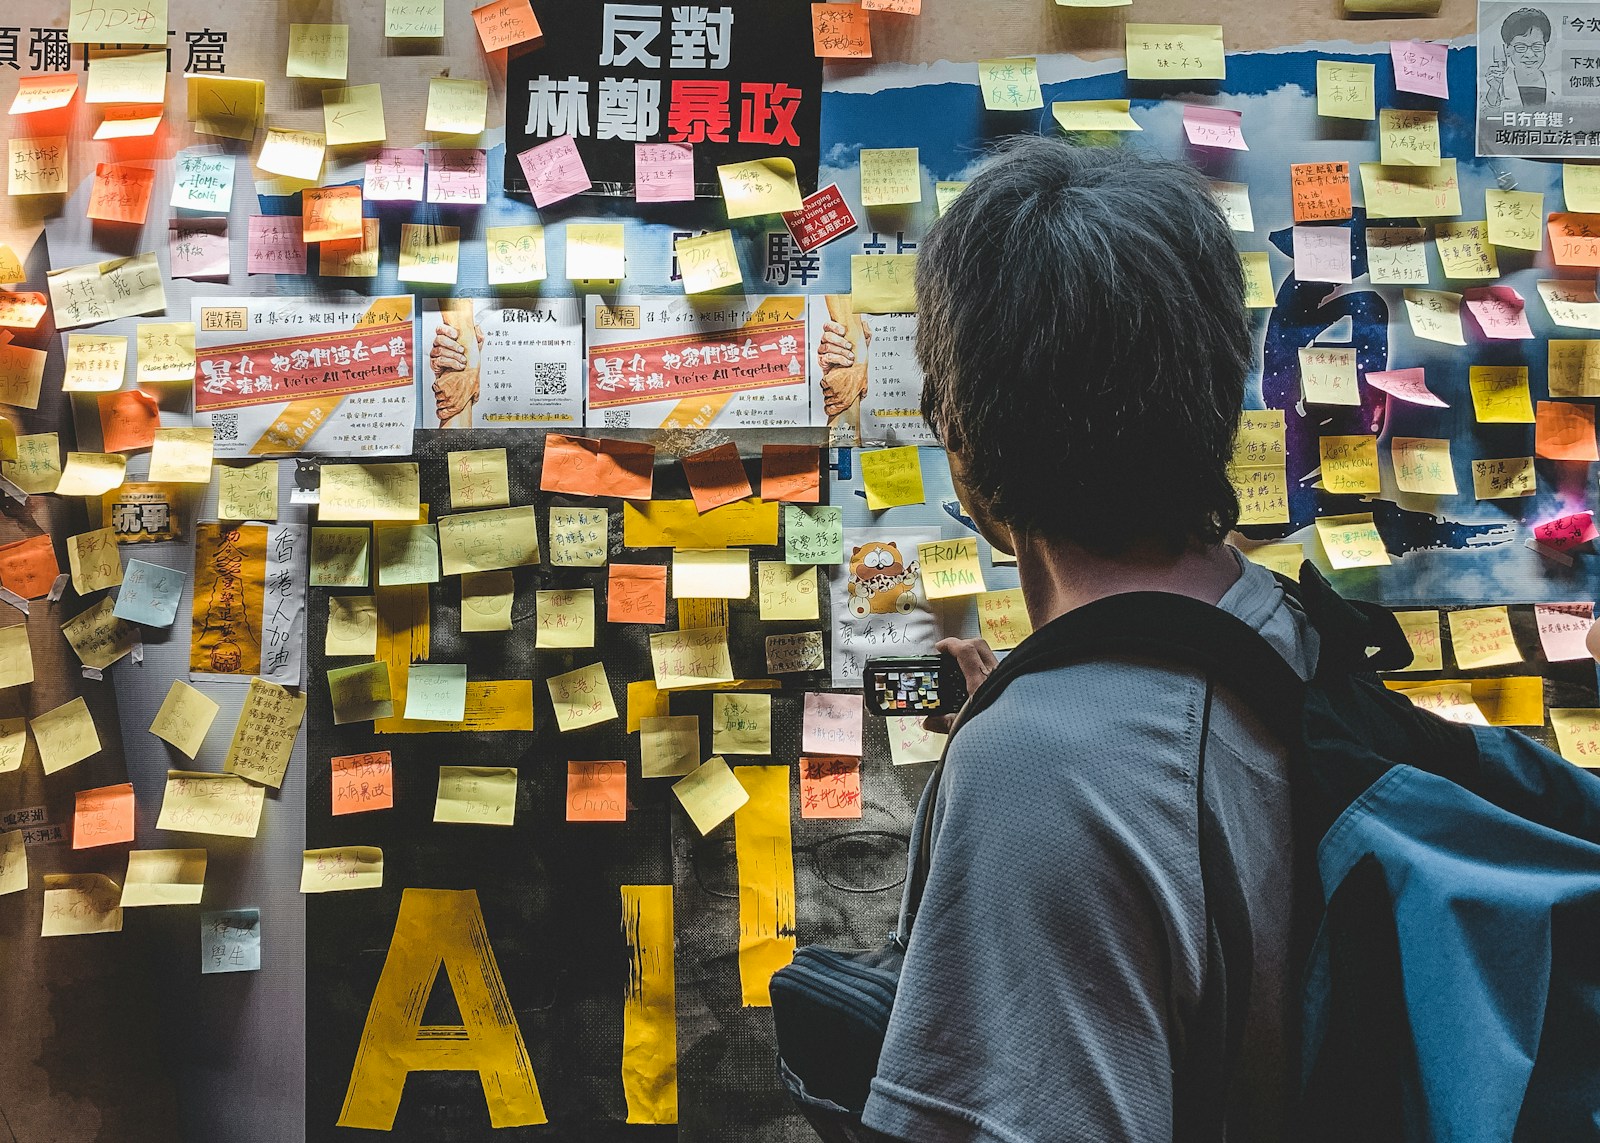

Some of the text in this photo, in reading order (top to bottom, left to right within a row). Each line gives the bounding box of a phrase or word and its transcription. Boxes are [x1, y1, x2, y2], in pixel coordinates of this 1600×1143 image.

[76, 7, 156, 31] 加油
[599, 3, 734, 69] 反對
[987, 62, 1034, 82] 反送中
[1327, 67, 1365, 83] 民主
[525, 75, 802, 146] 林鄭暴政
[14, 150, 60, 165] 五大訴求
[373, 154, 407, 175] 香港
[436, 153, 482, 184] 香港
[187, 190, 217, 203] KONG
[433, 184, 481, 202] 加油
[803, 194, 831, 212] Charging
[790, 197, 841, 228] Stop Using Force
[1493, 201, 1541, 220] 香港人
[804, 209, 839, 234] 無人衝擊
[205, 311, 243, 329] 徵稿
[502, 309, 558, 324] 徵稿尋人
[599, 309, 635, 327] 徵稿
[283, 362, 398, 389] We're All Together
[673, 361, 788, 386] We're All Together
[1323, 442, 1349, 462] Keep
[1328, 460, 1374, 473] HONG KONG
[1333, 474, 1367, 489] Home
[112, 503, 169, 535] 抗爭
[920, 542, 969, 565] FROM
[264, 527, 294, 670] 香港人加油
[541, 613, 584, 631] 不能少
[559, 675, 604, 699] 香港人
[567, 698, 603, 721] 加油
[580, 762, 613, 782] NO
[571, 792, 624, 814] China
[211, 944, 246, 968] 學生
